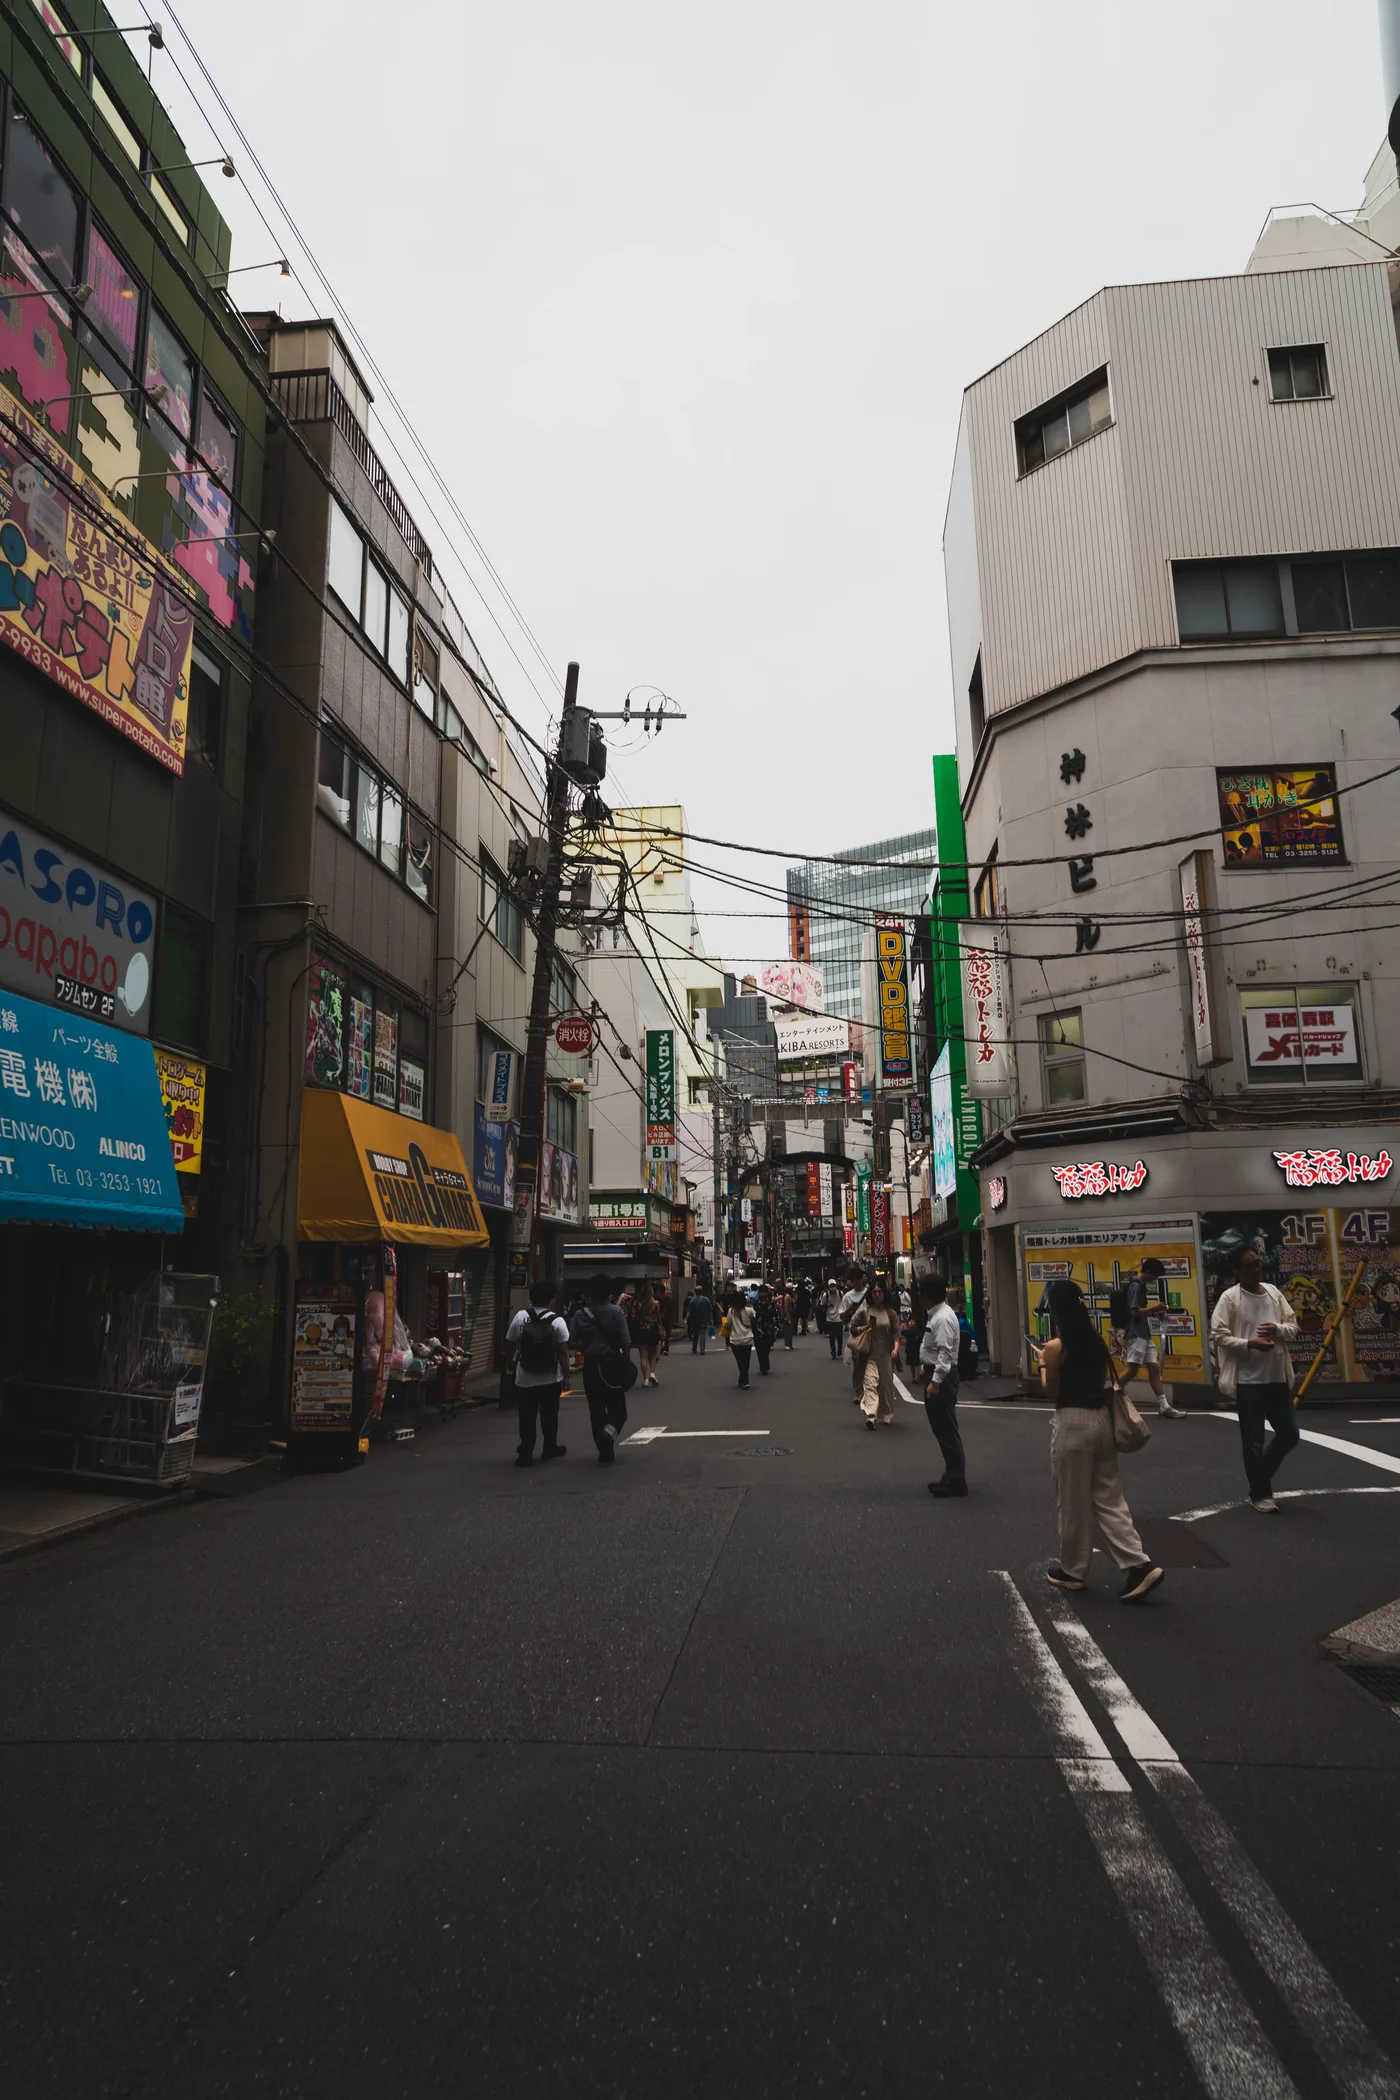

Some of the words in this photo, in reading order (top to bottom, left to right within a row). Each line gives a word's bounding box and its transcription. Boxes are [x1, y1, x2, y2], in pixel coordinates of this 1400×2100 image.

[55, 666, 185, 776] www.superpotato.com
[1219, 775, 1270, 792] ひざ枕
[1245, 791, 1299, 809] 耳かき
[0, 830, 153, 945] ASPRO
[57, 977, 97, 1011] フジムセン
[100, 995, 115, 1016] 2F
[0, 1008, 20, 1033] 線
[779, 1023, 844, 1038] エンターテインメント
[53, 1028, 120, 1064] パーツ全般
[558, 1027, 589, 1042] 消火栓
[775, 1040, 808, 1054] KIBA
[808, 1037, 845, 1050] RESORTS
[156, 1056, 204, 1087] トロゲーム
[882, 1077, 912, 1089] 受付3F
[98, 1137, 146, 1162] ALINCO
[652, 1146, 670, 1158] B1
[372, 1153, 395, 1173] HOBBY
[393, 1158, 410, 1177] SHOP
[1272, 1149, 1393, 1187] 福福トレカ
[76, 1168, 162, 1195] 03-3253-1921
[1051, 1159, 1148, 1198] 福福トレカ
[374, 1174, 432, 1227] CHARA
[436, 1187, 481, 1233] MART
[1026, 1232, 1148, 1247] 福福トレカ秋葉原エリアマップ
[1280, 1214, 1327, 1246] 1F
[1342, 1211, 1390, 1244] 4F
